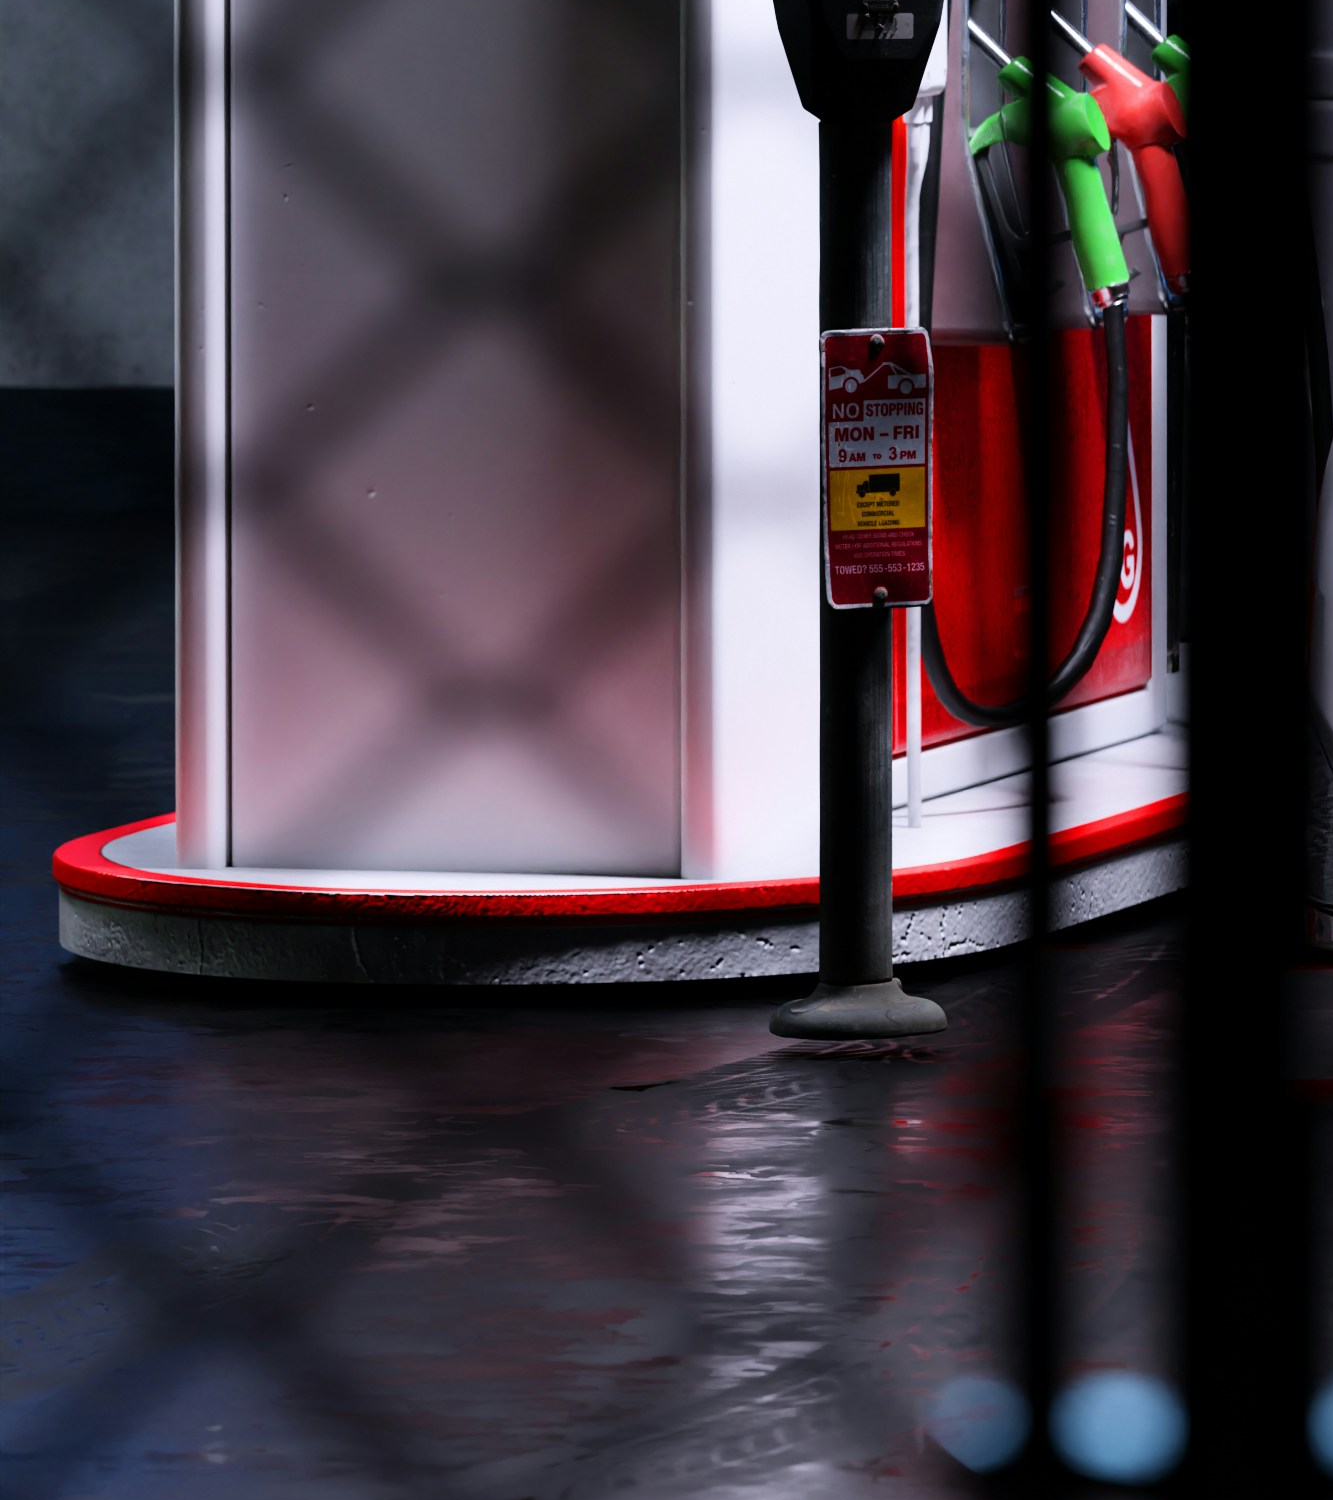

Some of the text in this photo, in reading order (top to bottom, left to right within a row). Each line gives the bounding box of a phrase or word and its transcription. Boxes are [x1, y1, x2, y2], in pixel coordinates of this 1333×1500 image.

[832, 401, 923, 419] NO STOPPING
[834, 426, 874, 442] MON
[893, 424, 919, 440] FRI
[835, 565, 867, 575] TOWED?
